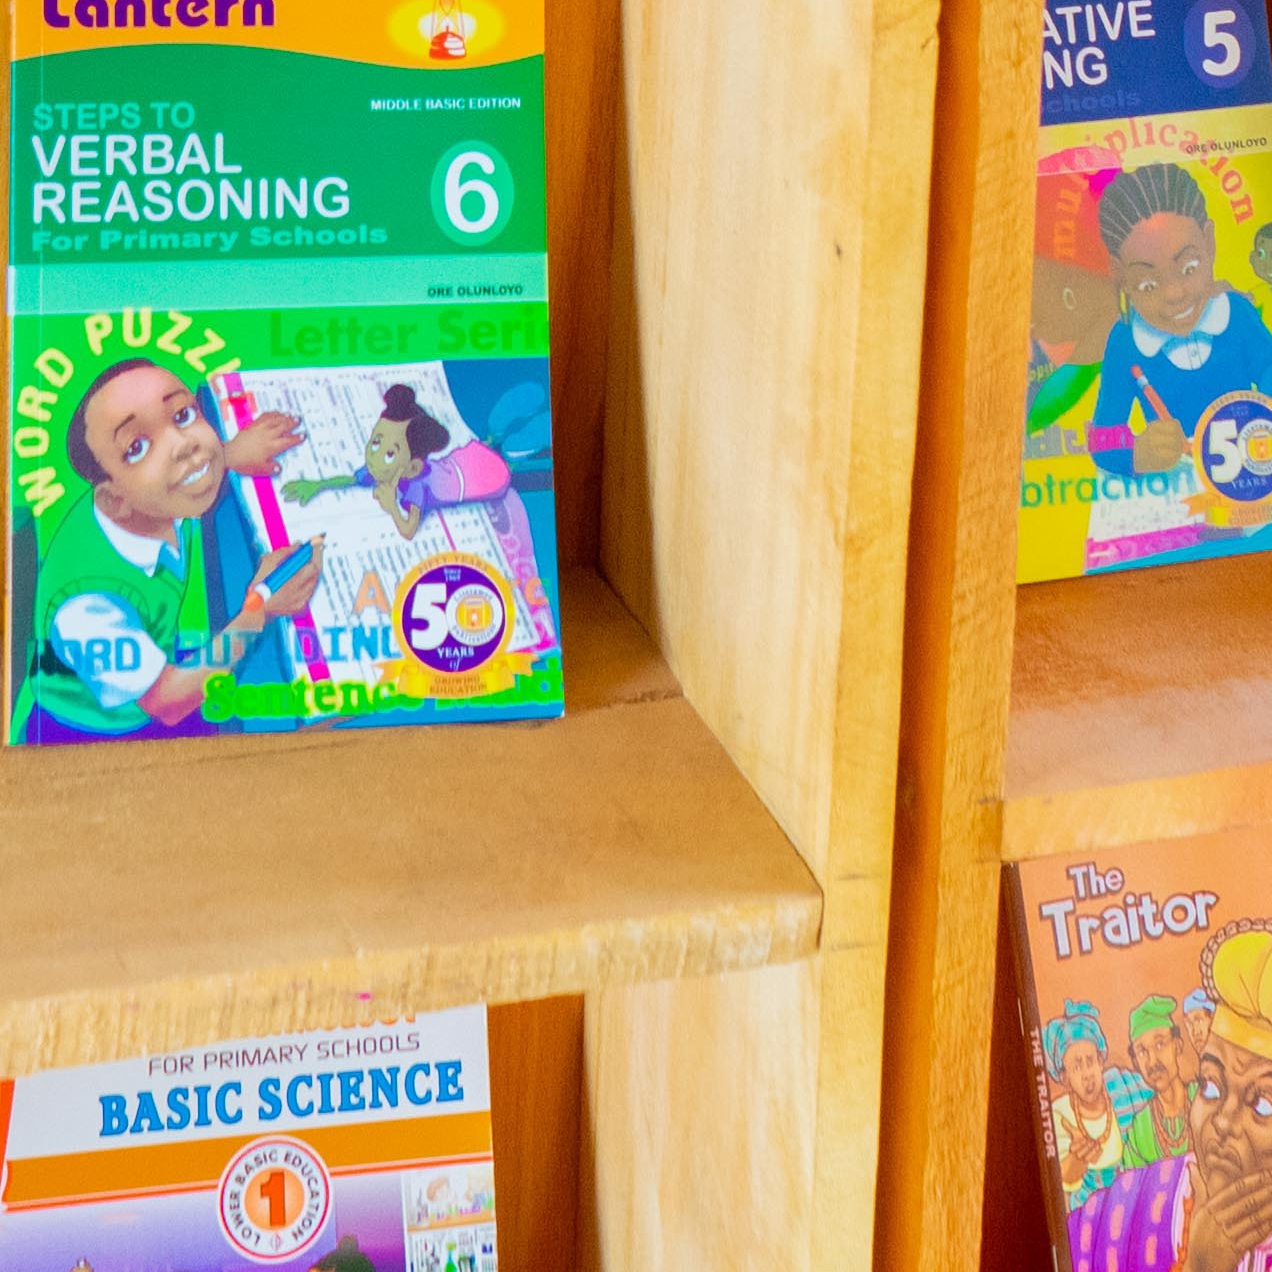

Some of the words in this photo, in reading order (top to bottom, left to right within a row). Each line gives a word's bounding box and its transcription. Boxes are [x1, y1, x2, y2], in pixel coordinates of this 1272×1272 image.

[1202, 10, 1241, 77] 5
[33, 102, 140, 131] STEPS
[150, 102, 195, 127] TO
[371, 99, 421, 111] MIDDLE
[426, 98, 465, 110] BASIC
[469, 97, 521, 109] EDITION
[32, 133, 242, 178] VERBAL
[33, 176, 350, 224] REASONING
[443, 151, 500, 234] 6
[33, 229, 88, 252] For
[100, 225, 238, 254] Primary
[251, 223, 388, 248] Schools
[427, 285, 453, 298] ORE
[457, 284, 523, 297] OLUNLOYO
[411, 583, 503, 650] 50
[438, 647, 474, 658] YEARS
[1068, 861, 1124, 901] The
[1040, 891, 1219, 959] Traitor
[149, 1055, 194, 1076] FOR
[204, 1045, 306, 1071] PRIMARY
[317, 1033, 420, 1060] SCHOOLS
[99, 1081, 243, 1136] BASIC
[257, 1060, 464, 1121] SCIENCE
[261, 1171, 286, 1227] 1
